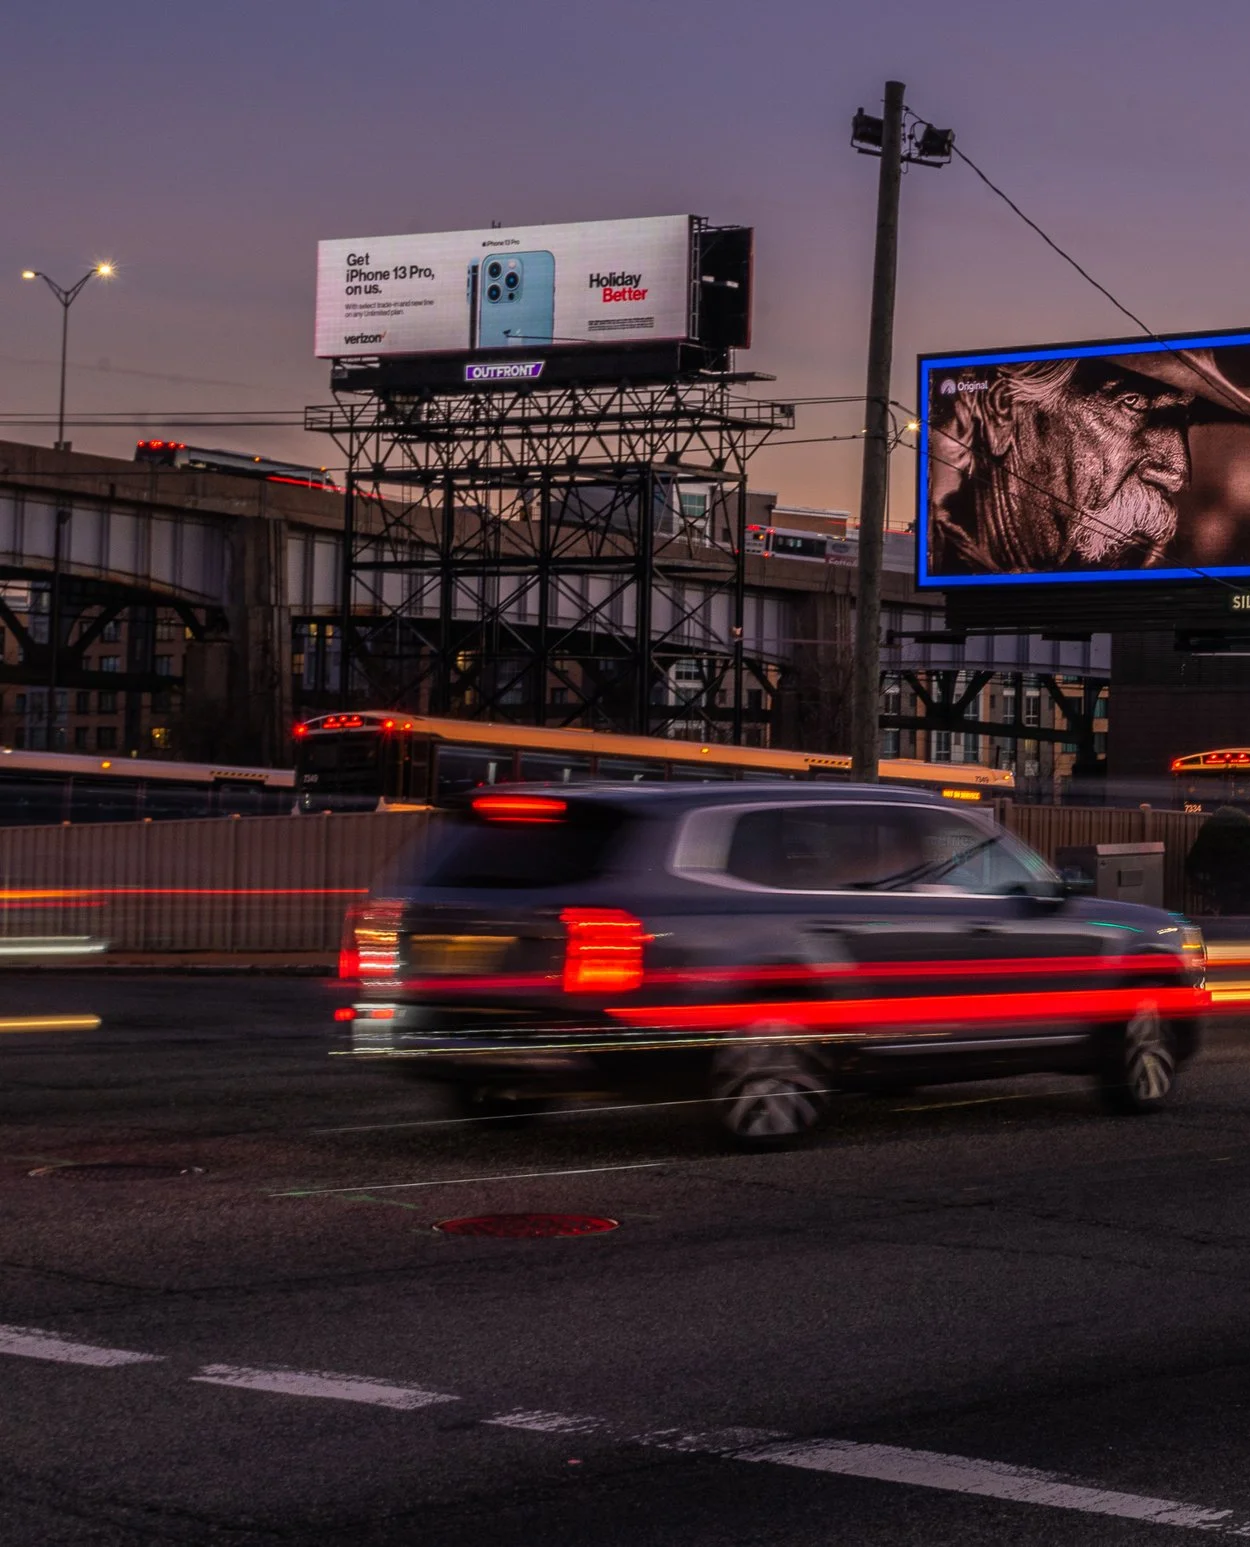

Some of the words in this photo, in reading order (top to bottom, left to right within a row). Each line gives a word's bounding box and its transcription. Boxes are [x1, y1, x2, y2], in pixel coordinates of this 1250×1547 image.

[346, 252, 370, 266] Get
[346, 269, 390, 282] iPhone
[392, 266, 407, 280] 13
[409, 265, 435, 280] Pro,
[589, 271, 642, 288] Holiday
[345, 285, 362, 296] on
[364, 284, 382, 295] us.
[602, 287, 648, 303] Better
[344, 332, 382, 344] verizon
[472, 364, 536, 379] OUTFRONT
[957, 380, 988, 393] Original
